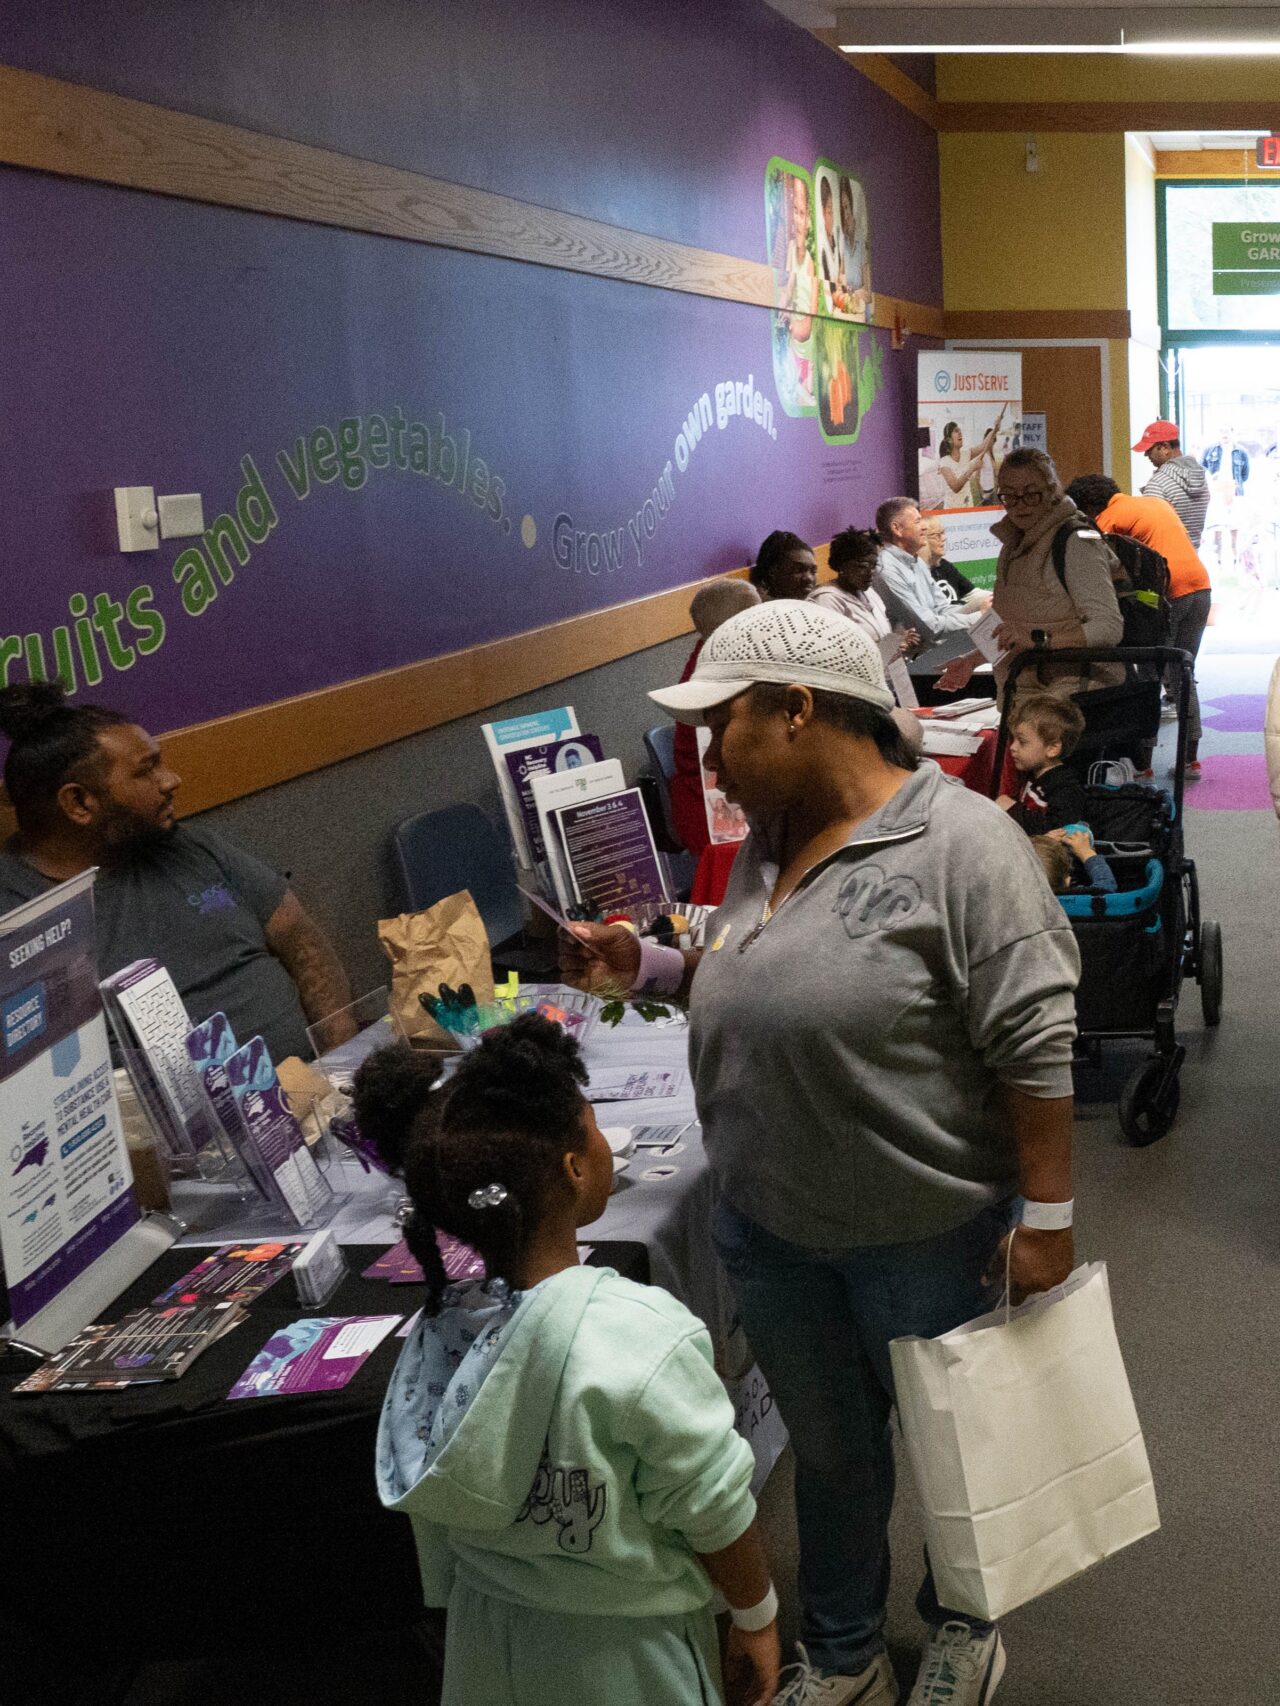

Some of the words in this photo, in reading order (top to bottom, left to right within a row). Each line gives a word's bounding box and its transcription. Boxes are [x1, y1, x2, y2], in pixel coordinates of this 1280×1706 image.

[1022, 422, 1042, 431] TAFF
[1023, 433, 1041, 442] NLY
[552, 511, 625, 575] Grow
[628, 460, 675, 567] your
[675, 393, 713, 473] own
[714, 373, 777, 440] garden.
[0, 584, 166, 696] ruits
[172, 453, 279, 617] and
[275, 404, 511, 535] vegetables.
[576, 804, 607, 818] November
[8, 933, 46, 969] SEEKING
[44, 918, 72, 948] HELP?
